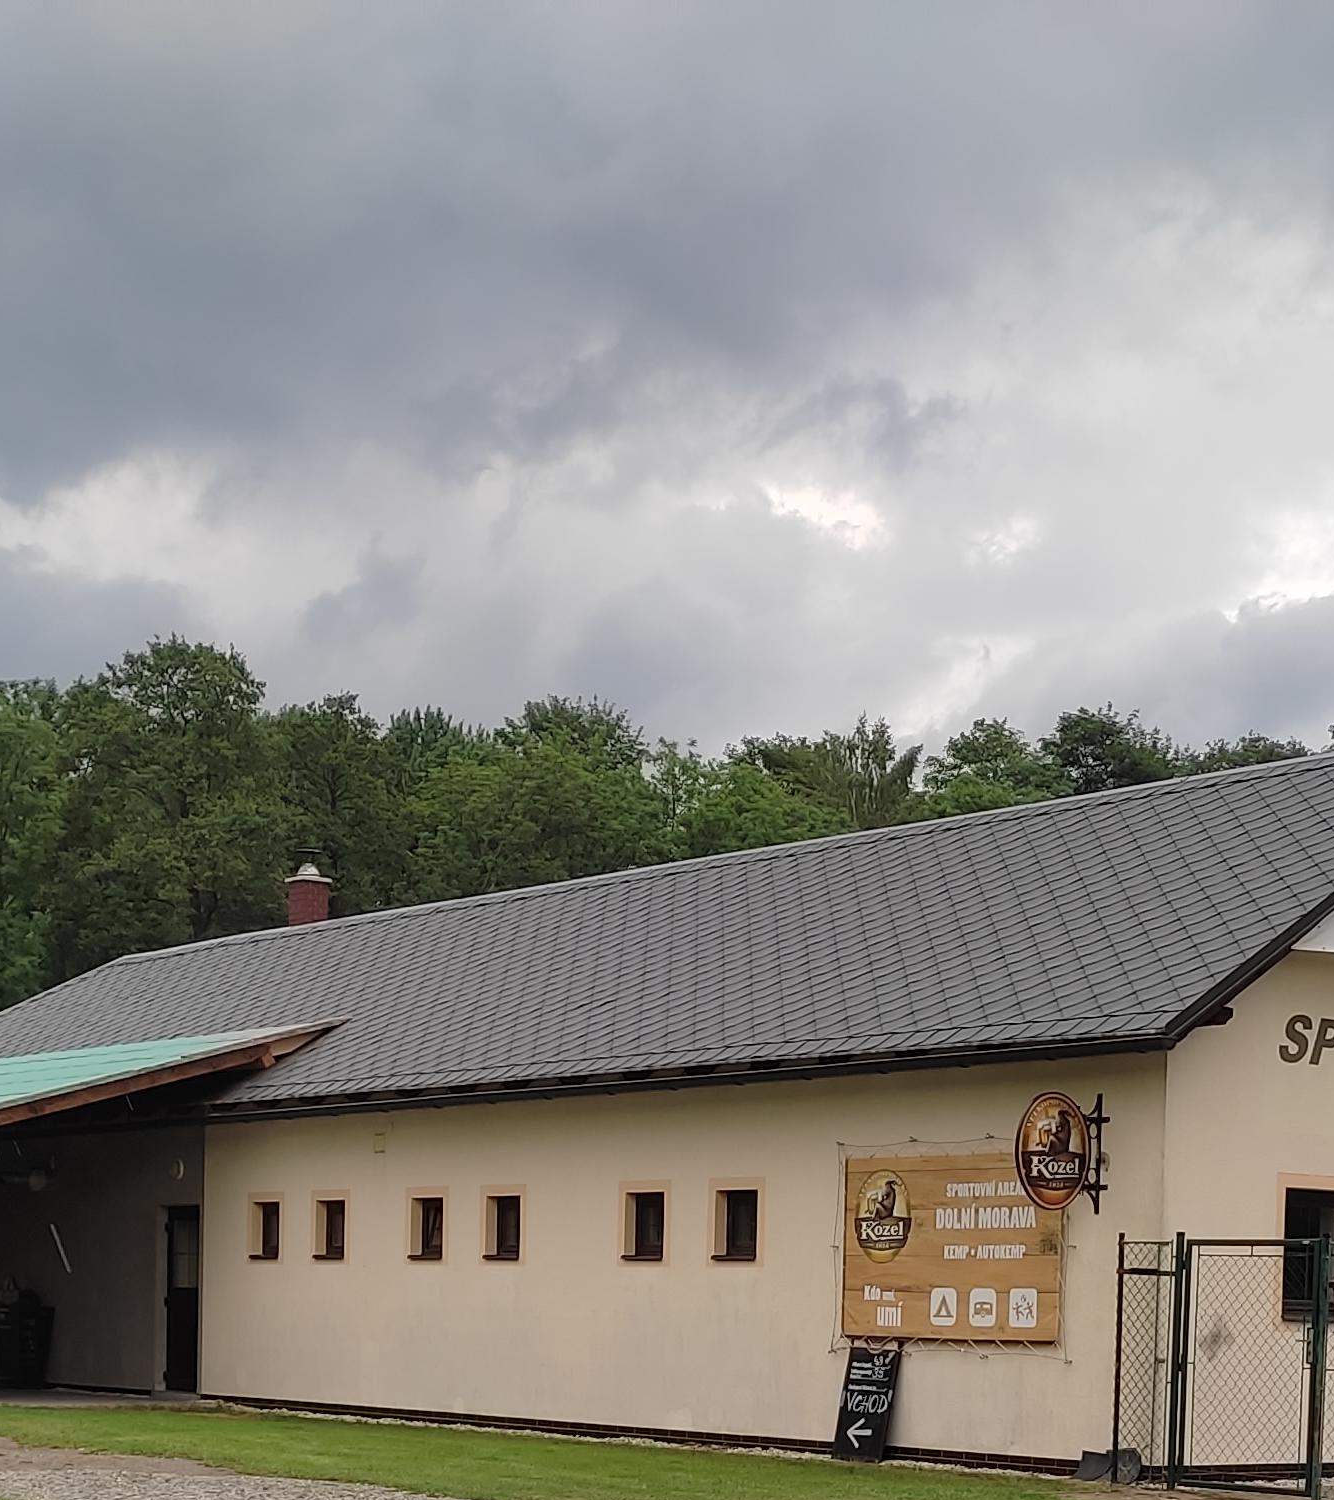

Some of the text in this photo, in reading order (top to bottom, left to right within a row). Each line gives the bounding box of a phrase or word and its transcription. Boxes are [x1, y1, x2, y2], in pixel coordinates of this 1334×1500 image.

[1030, 1156, 1079, 1178] Kozel
[946, 1180, 996, 1197] SPORTOVNÍ
[936, 1203, 1036, 1229] DOLNÍ MORAVA
[860, 1221, 904, 1240] Kozel
[943, 1244, 1026, 1259] KEMP AUTOKEMP
[847, 1392, 888, 1414] VCHOD
